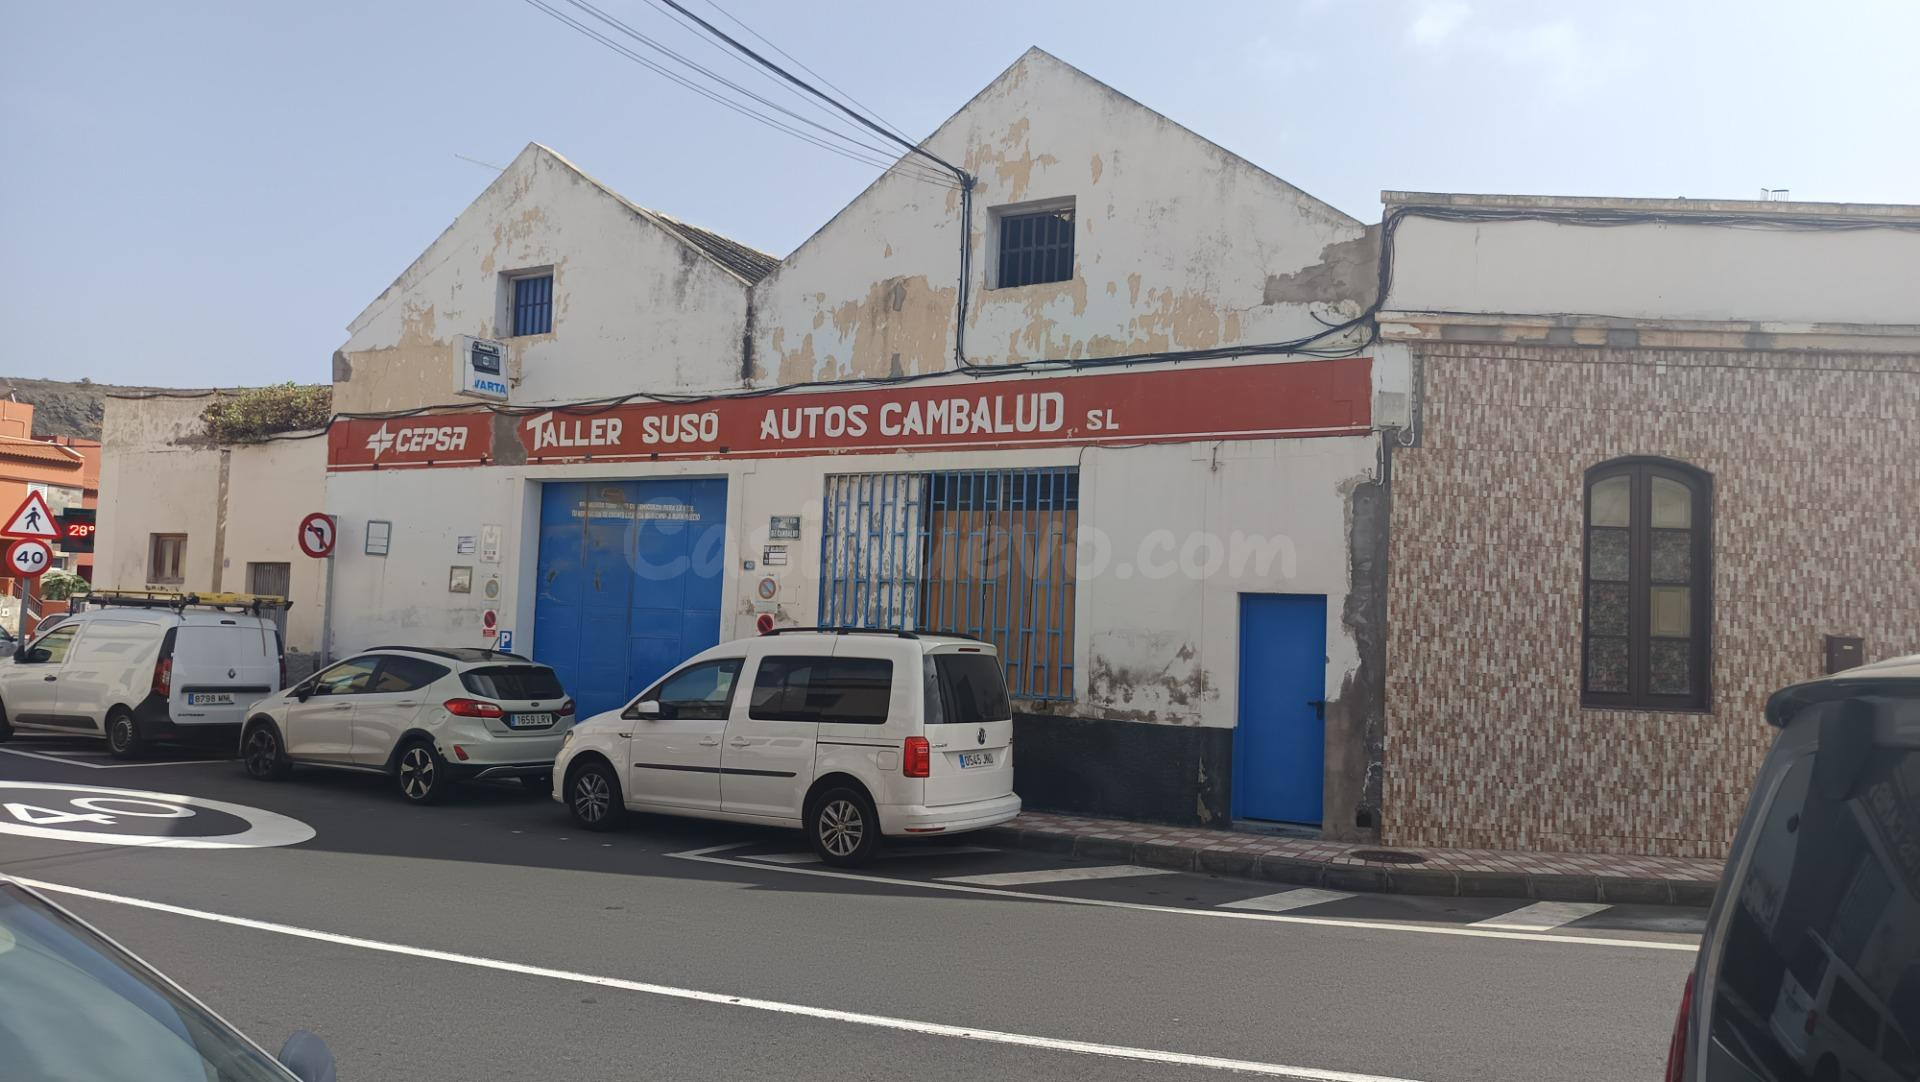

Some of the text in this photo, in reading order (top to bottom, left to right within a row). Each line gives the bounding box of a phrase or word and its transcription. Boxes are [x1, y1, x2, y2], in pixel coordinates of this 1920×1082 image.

[474, 379, 506, 394] VARTA
[759, 391, 1120, 440] AUTOS CAMBALUD SL
[396, 426, 468, 452] CEPSA
[526, 411, 622, 451] TALLER
[16, 551, 43, 564] 40
[501, 632, 510, 647] P
[3, 797, 197, 825] 40
